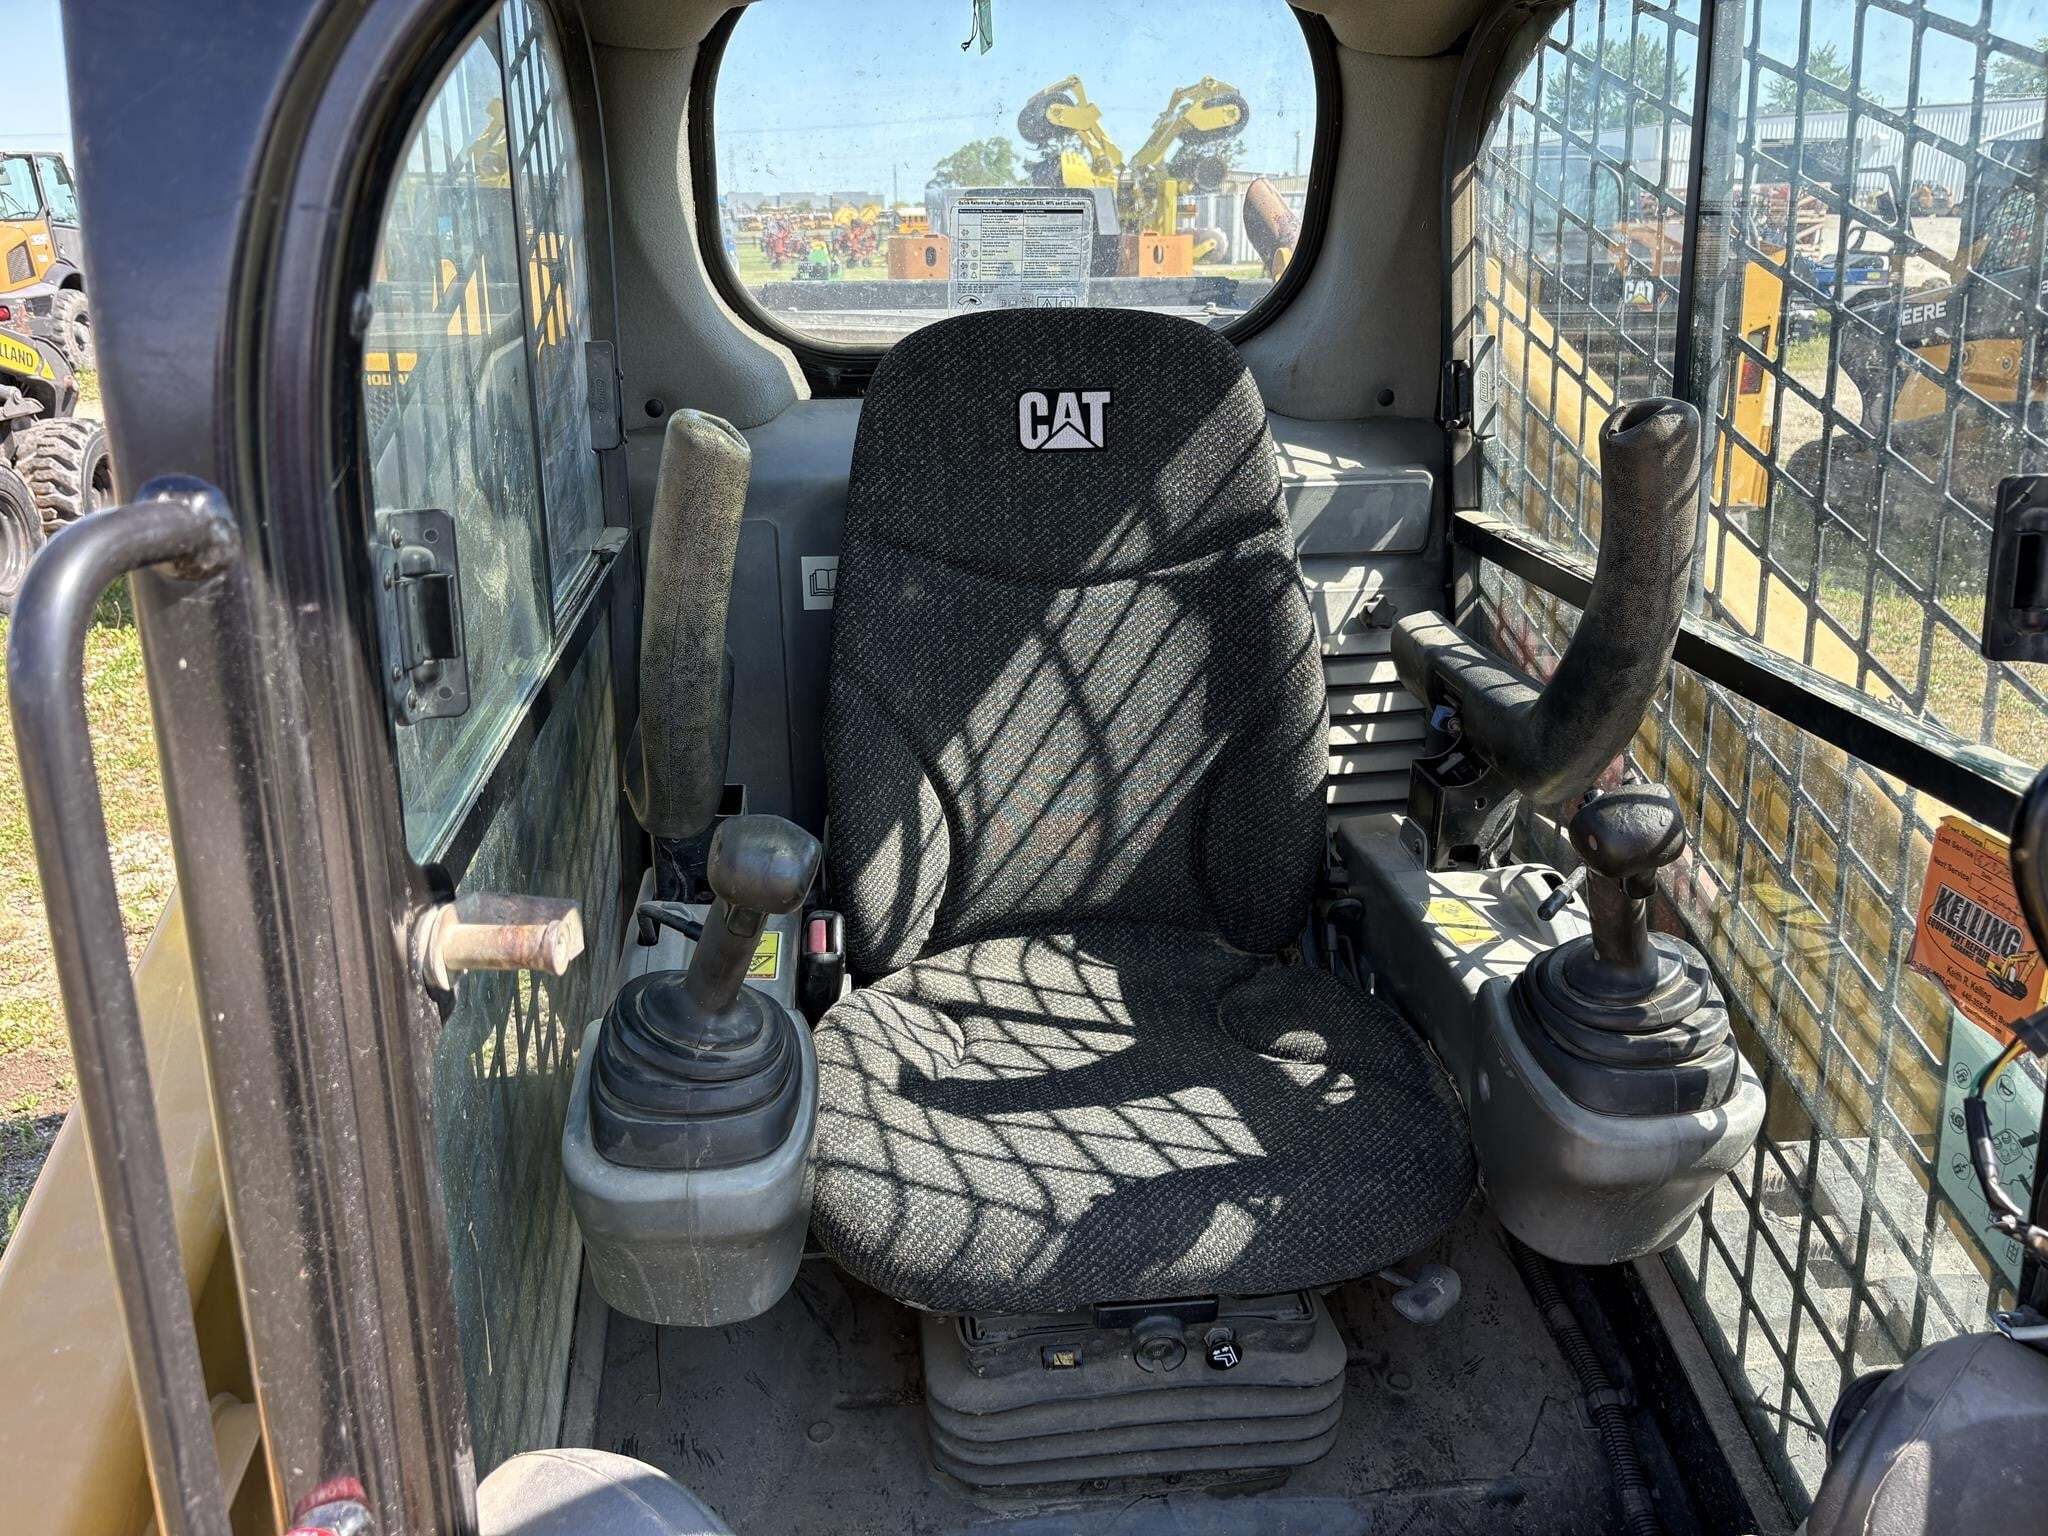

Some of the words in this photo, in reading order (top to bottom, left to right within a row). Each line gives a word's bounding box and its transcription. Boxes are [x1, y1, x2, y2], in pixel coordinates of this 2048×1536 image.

[1624, 279, 1654, 304] CAT
[1901, 300, 1947, 326] EERE
[1019, 391, 1111, 450] CAT
[1938, 833, 1951, 846] Last
[1951, 840, 1974, 858] Service
[1946, 864, 1970, 882] Service
[1932, 885, 2023, 959] KELLING
[1927, 916, 1965, 943] EQUIPMENT
[1964, 938, 1991, 961] REPAIR
[1947, 966, 1963, 981] Keith
[1970, 981, 1992, 1004] Kelling
